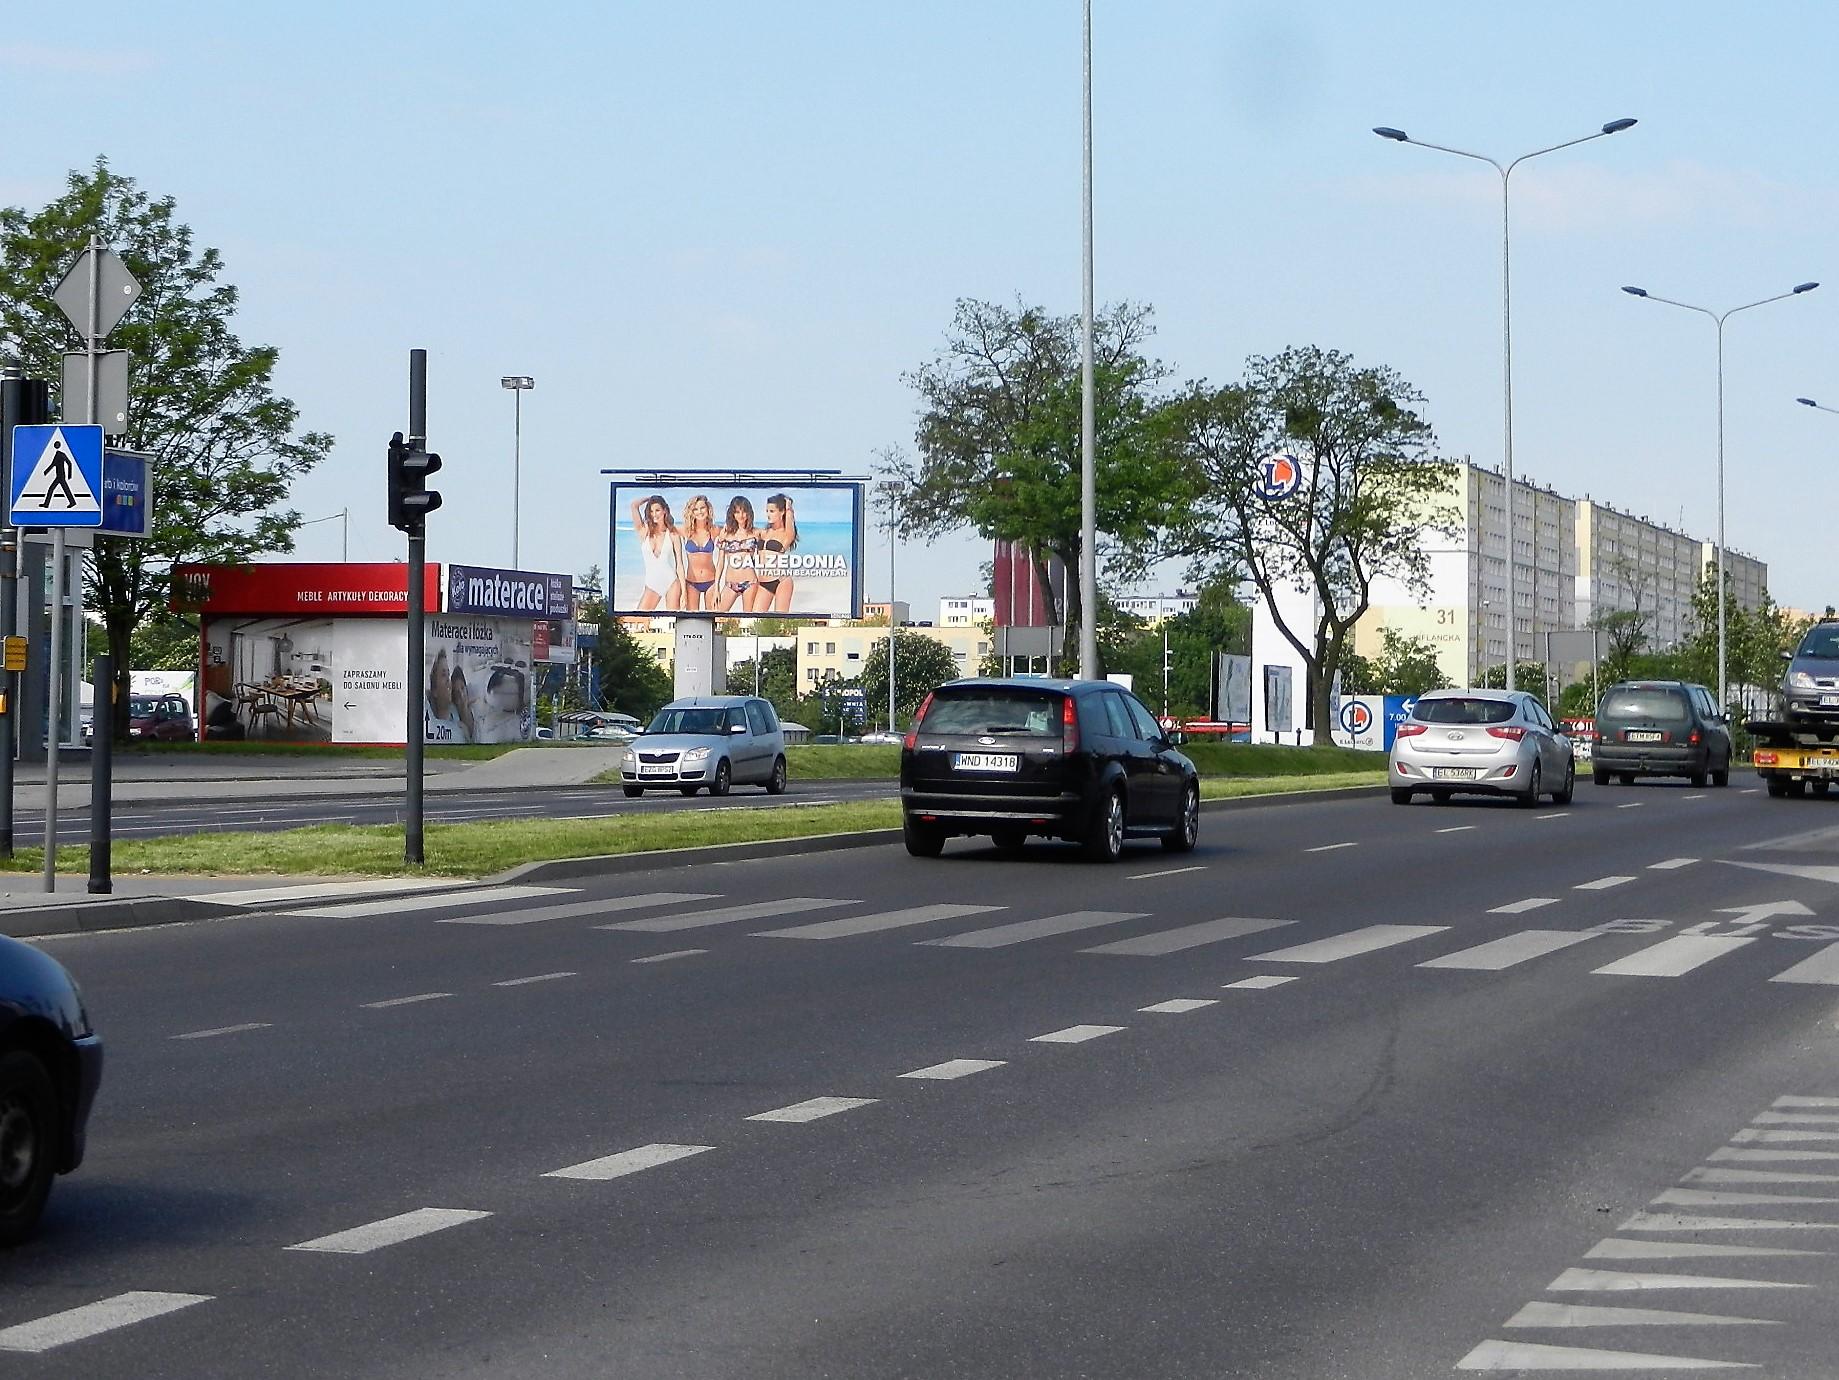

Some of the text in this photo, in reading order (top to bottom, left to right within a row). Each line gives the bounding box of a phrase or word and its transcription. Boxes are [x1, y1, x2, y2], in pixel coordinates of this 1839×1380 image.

[729, 554, 847, 570] CALZEDONIA
[794, 568, 848, 578] BEACHWEAR
[297, 592, 322, 602] MEBLE
[327, 591, 366, 602] ARTYKUŁY
[468, 574, 544, 611] materace
[1437, 609, 1454, 625] 31
[431, 620, 468, 640] Materace
[469, 622, 472, 640] i
[343, 670, 387, 679] ZAPRASZAMY
[343, 681, 402, 690] DO SALONU MEBLI
[435, 725, 452, 740] 20m
[961, 755, 1016, 768] WND 14318
